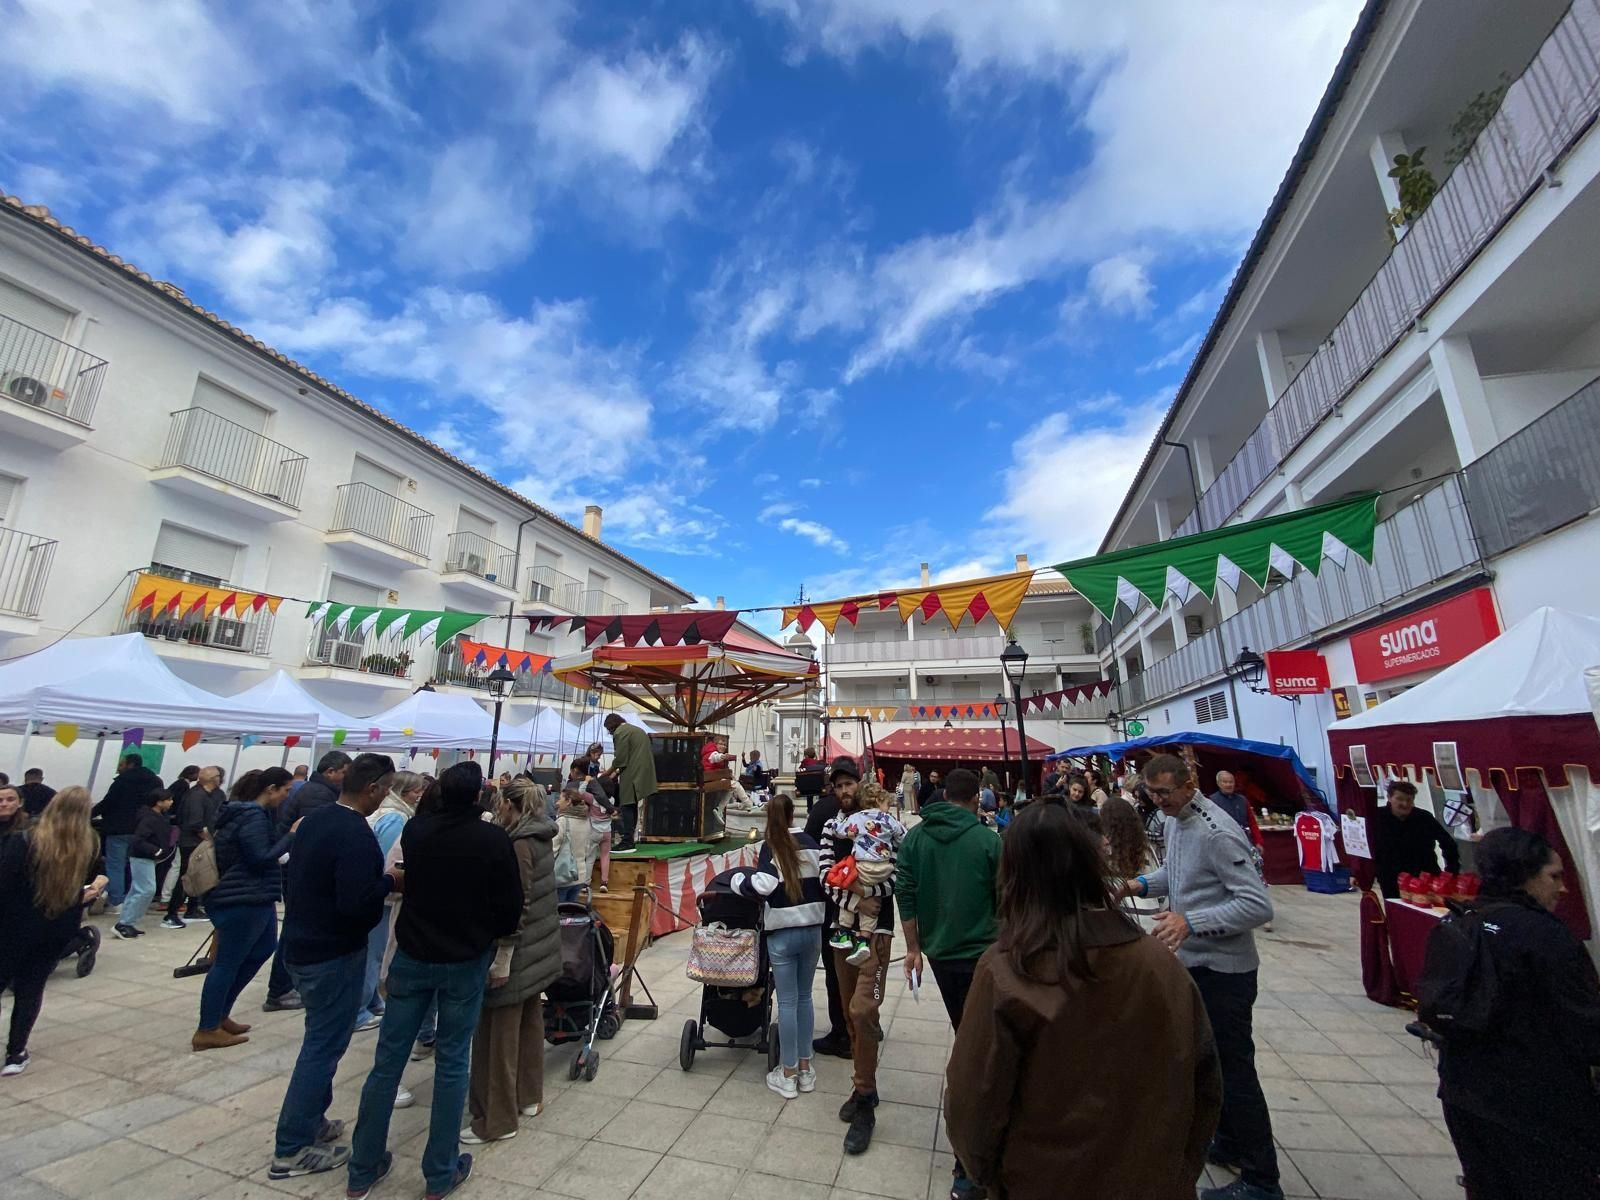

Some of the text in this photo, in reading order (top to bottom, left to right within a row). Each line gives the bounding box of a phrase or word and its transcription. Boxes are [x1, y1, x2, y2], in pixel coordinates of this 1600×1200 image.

[1380, 620, 1437, 656] suma
[1384, 647, 1440, 668] SUPERMERCADOS
[1275, 677, 1317, 687] suma
